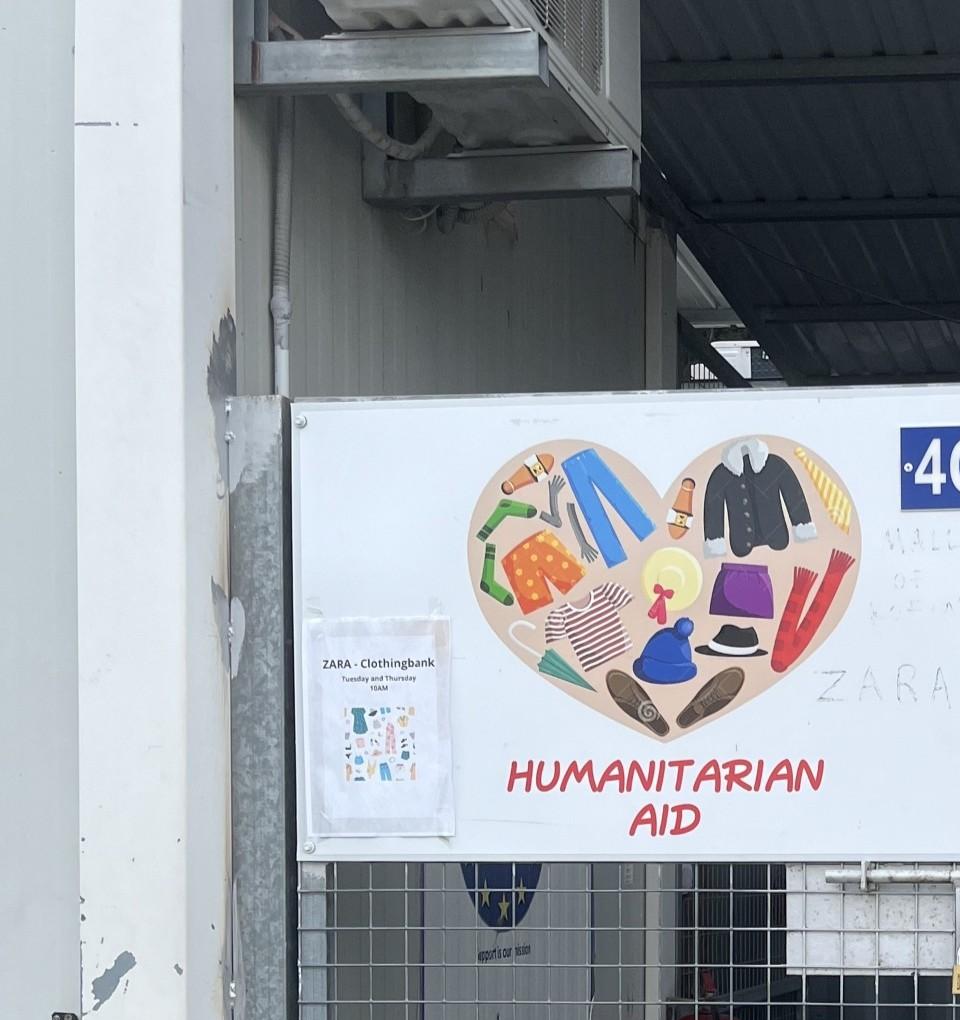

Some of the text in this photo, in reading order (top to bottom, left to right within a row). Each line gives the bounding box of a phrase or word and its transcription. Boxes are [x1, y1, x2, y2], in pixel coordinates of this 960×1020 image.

[322, 659, 352, 669] ZARA
[360, 658, 435, 671] Clothingbank
[385, 675, 416, 683] Thursday
[814, 664, 951, 709] ZARA
[507, 759, 825, 794] HUMANITARIAN
[629, 803, 701, 837] AID
[476, 948, 497, 964] upport
[497, 946, 502, 960] is
[502, 947, 513, 958] our
